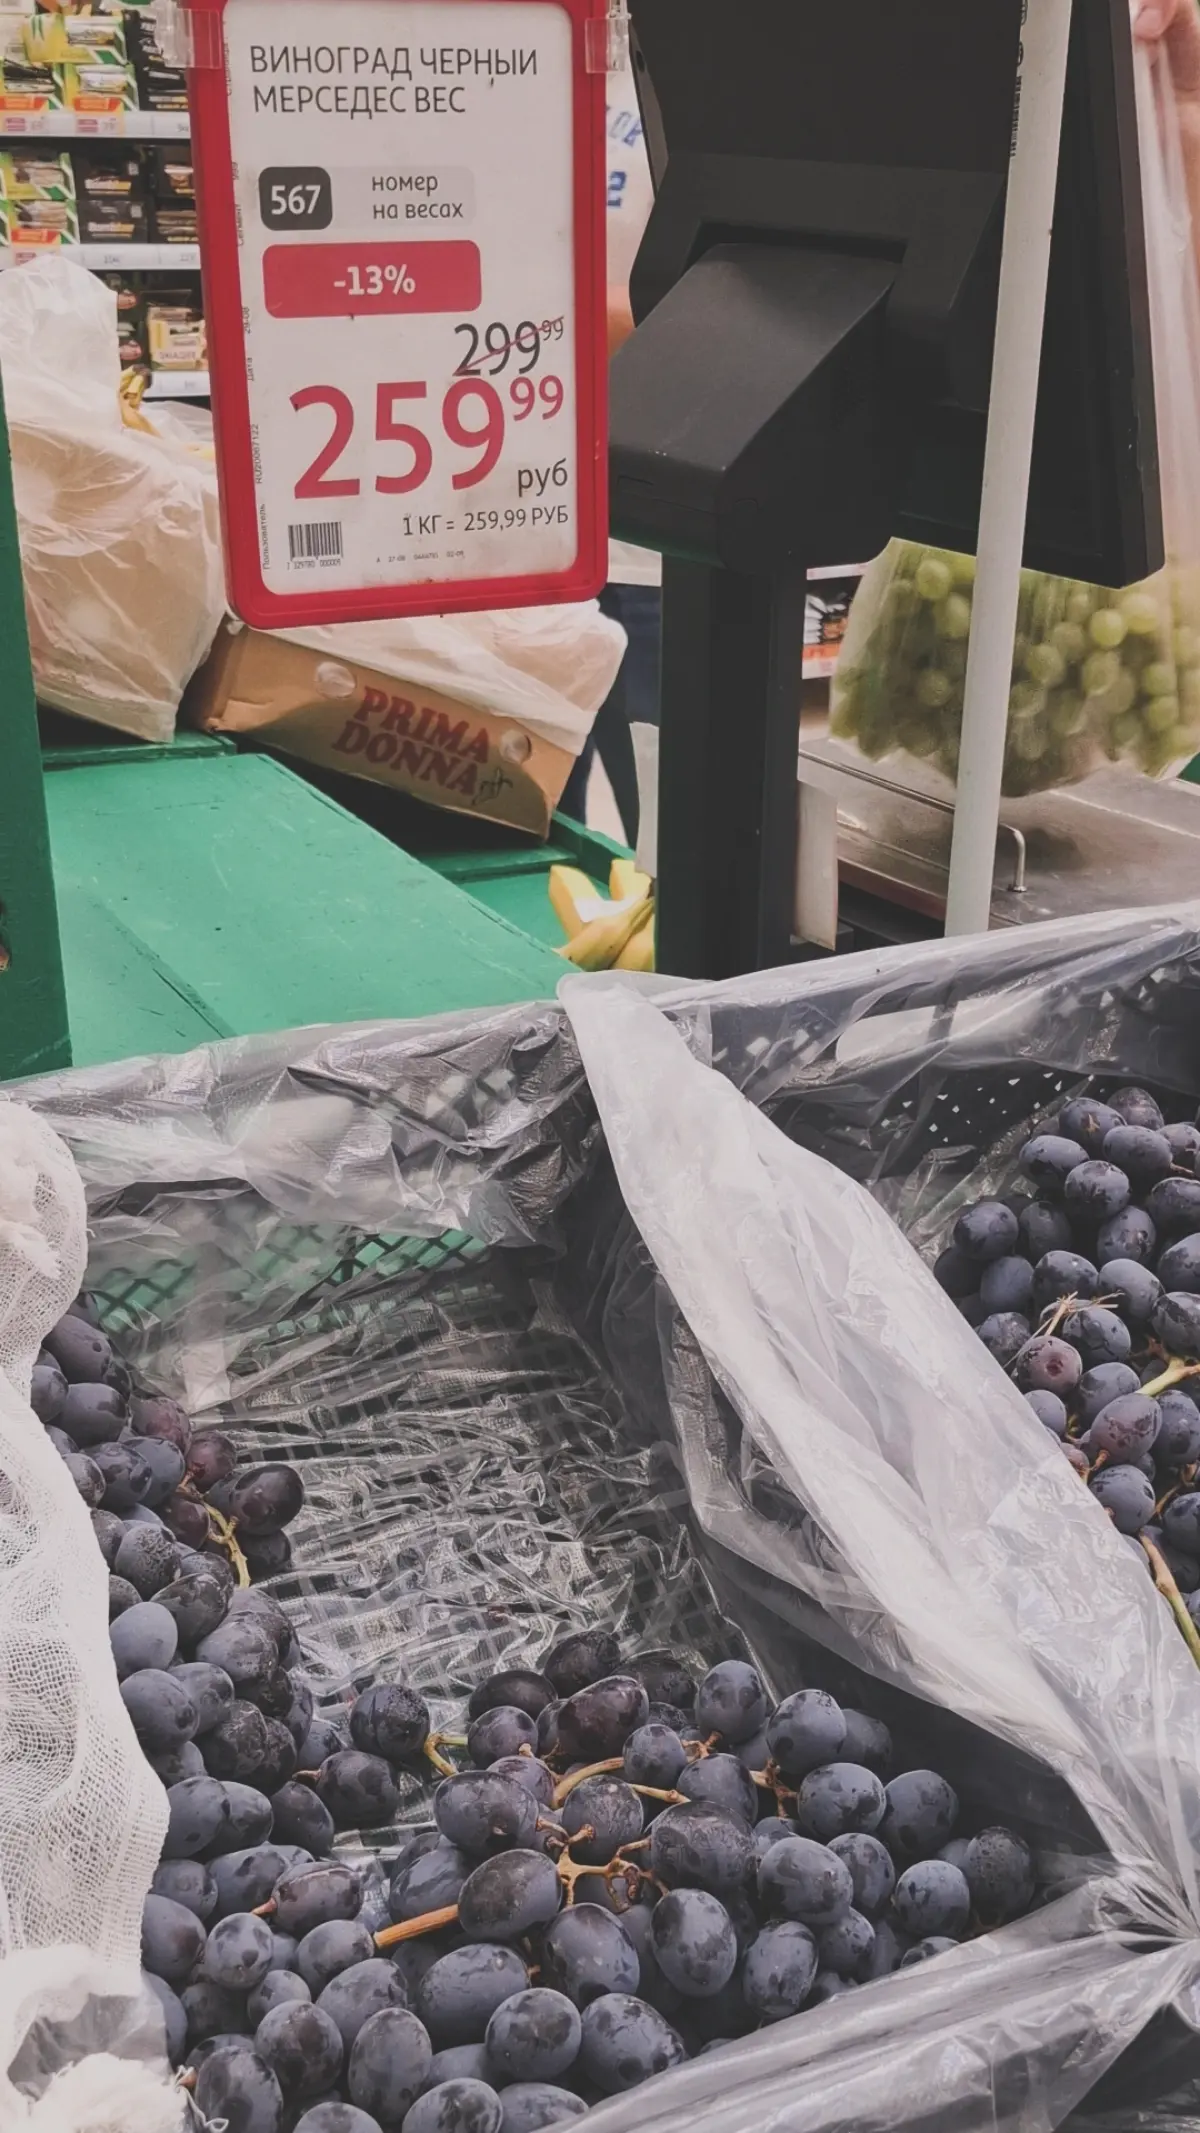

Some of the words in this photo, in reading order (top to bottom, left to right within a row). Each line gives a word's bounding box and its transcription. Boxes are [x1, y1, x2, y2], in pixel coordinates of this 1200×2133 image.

[250, 45, 412, 81] ВИНОГРАД
[253, 85, 407, 120] МЕРСЕДЕС
[415, 86, 466, 113] ВЕС
[271, 185, 321, 215] 567
[372, 175, 438, 197] номер
[373, 203, 398, 220] на
[405, 203, 463, 220] весах
[333, 263, 416, 296] -13%
[517, 458, 568, 497] руб
[403, 516, 413, 536] 1
[464, 509, 526, 532] 259,99
[532, 505, 569, 526] РУБ
[354, 686, 489, 764] PRIMA
[331, 720, 478, 796] DONNA
